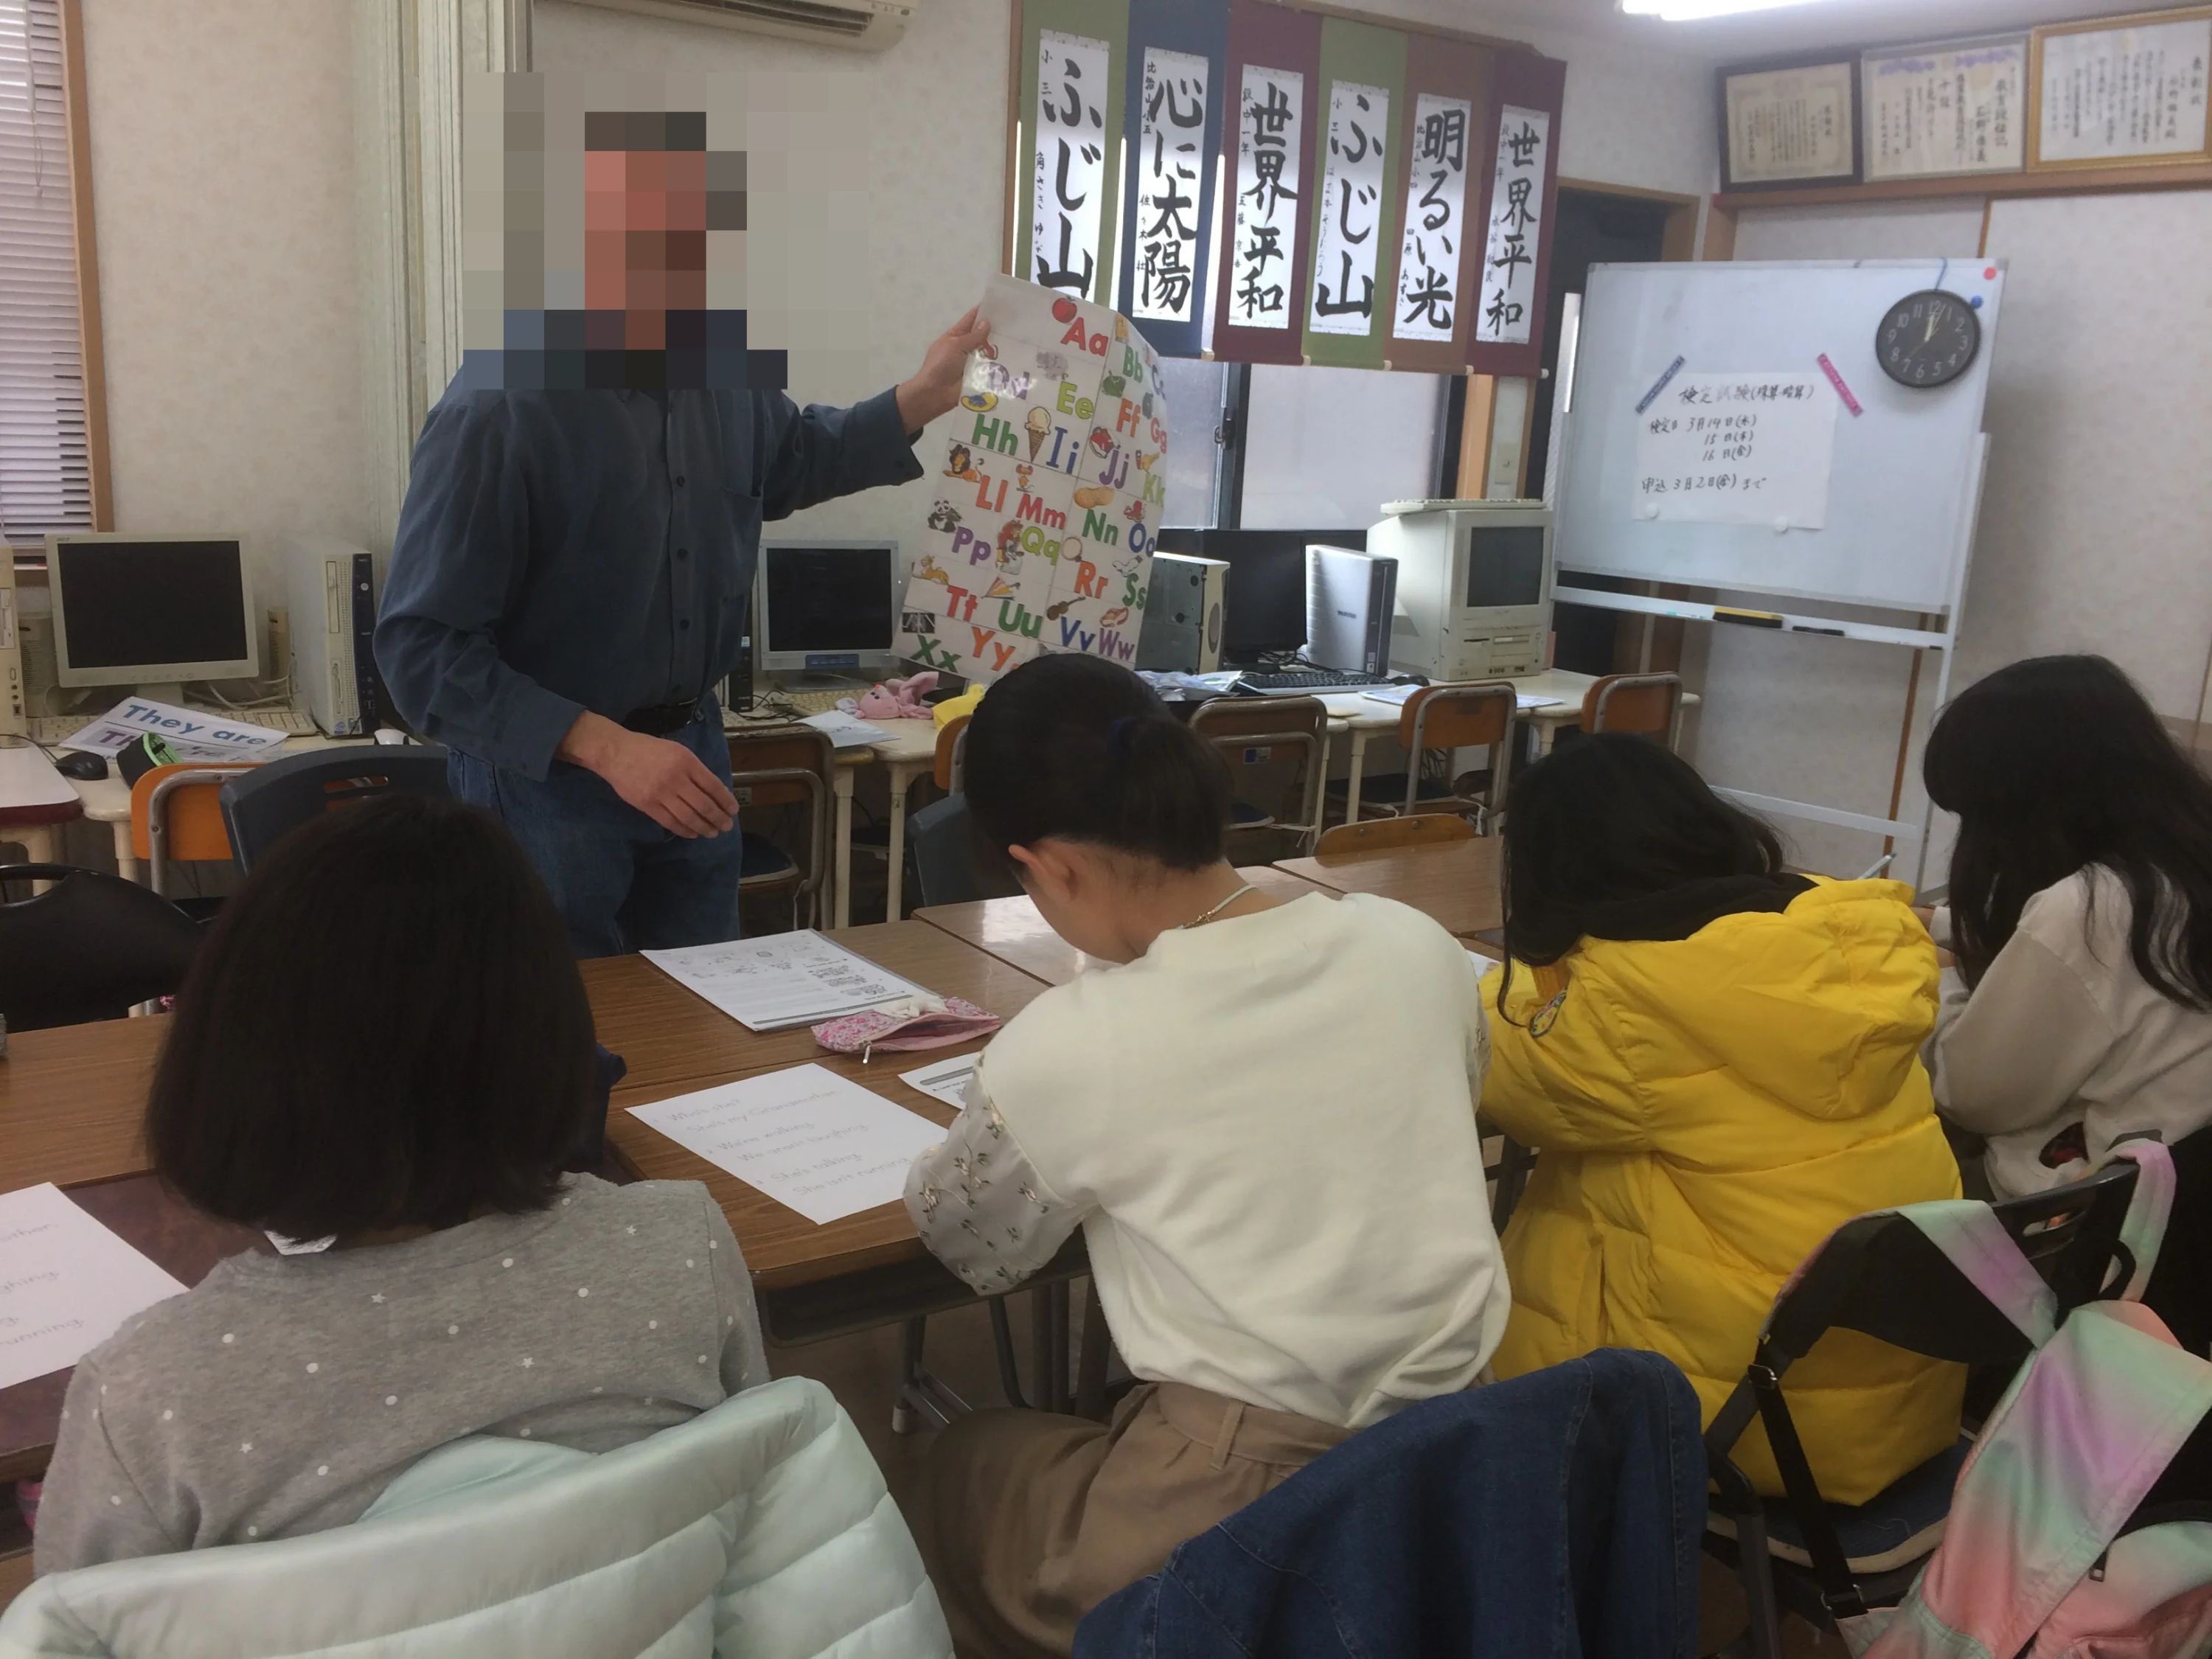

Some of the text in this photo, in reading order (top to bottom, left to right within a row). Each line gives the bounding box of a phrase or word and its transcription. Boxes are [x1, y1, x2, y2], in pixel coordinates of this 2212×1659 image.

[1036, 58, 1102, 299] ふじ山
[1141, 78, 1203, 313] 心に太陽
[1237, 81, 1298, 319] 世界平和
[1315, 94, 1383, 318] ふじ山
[1403, 110, 1465, 330] 明るい光
[1486, 122, 1540, 336] 世界平和
[1897, 313, 1909, 327] 10
[1913, 304, 1923, 318] 11
[1928, 299, 1941, 314] 12
[1947, 307, 1952, 321] 1
[1955, 317, 1965, 332] 2
[1061, 317, 1108, 356] Aa
[1123, 344, 1142, 383] Bb
[1888, 329, 1897, 344] 9
[1890, 347, 1899, 362] 8
[1959, 335, 1968, 350] 3
[1903, 358, 1911, 372] 7
[1916, 364, 1924, 378] 6
[1932, 361, 1942, 376] 5
[1947, 354, 1956, 366] 4
[1057, 382, 1093, 420] Ee
[1116, 397, 1141, 437] Ff
[972, 414, 1018, 456] Hh
[1046, 426, 1079, 474] Ii
[1099, 449, 1130, 490] Jj
[975, 475, 1155, 557] Ll Mm Nn Oo
[951, 526, 1146, 610] Pp Qq Rr Ss
[947, 585, 1135, 661] Tt Uu Vv Ww
[910, 626, 1016, 673] Xx Yy
[123, 703, 268, 747] They are
